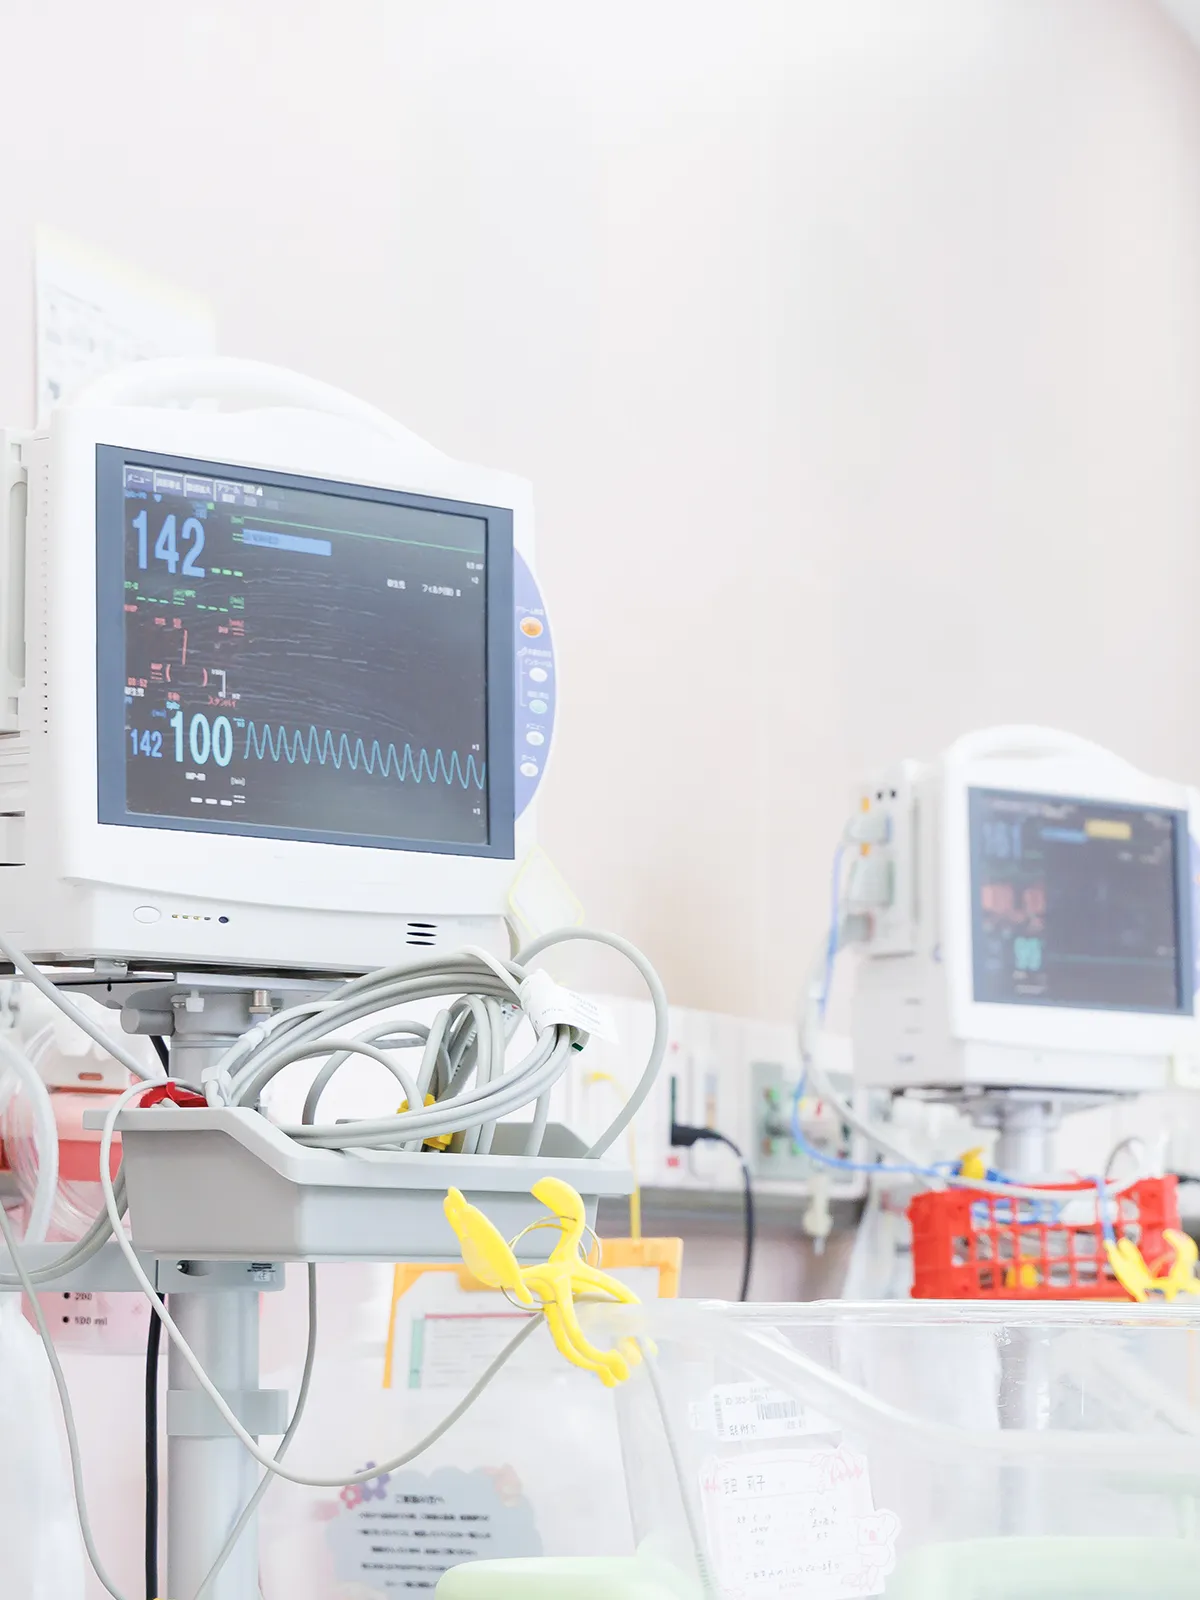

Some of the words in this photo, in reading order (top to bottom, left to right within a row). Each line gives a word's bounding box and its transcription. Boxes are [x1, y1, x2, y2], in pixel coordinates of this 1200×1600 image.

[132, 509, 205, 578] 142
[130, 728, 163, 758] 142
[170, 710, 233, 767] 100
